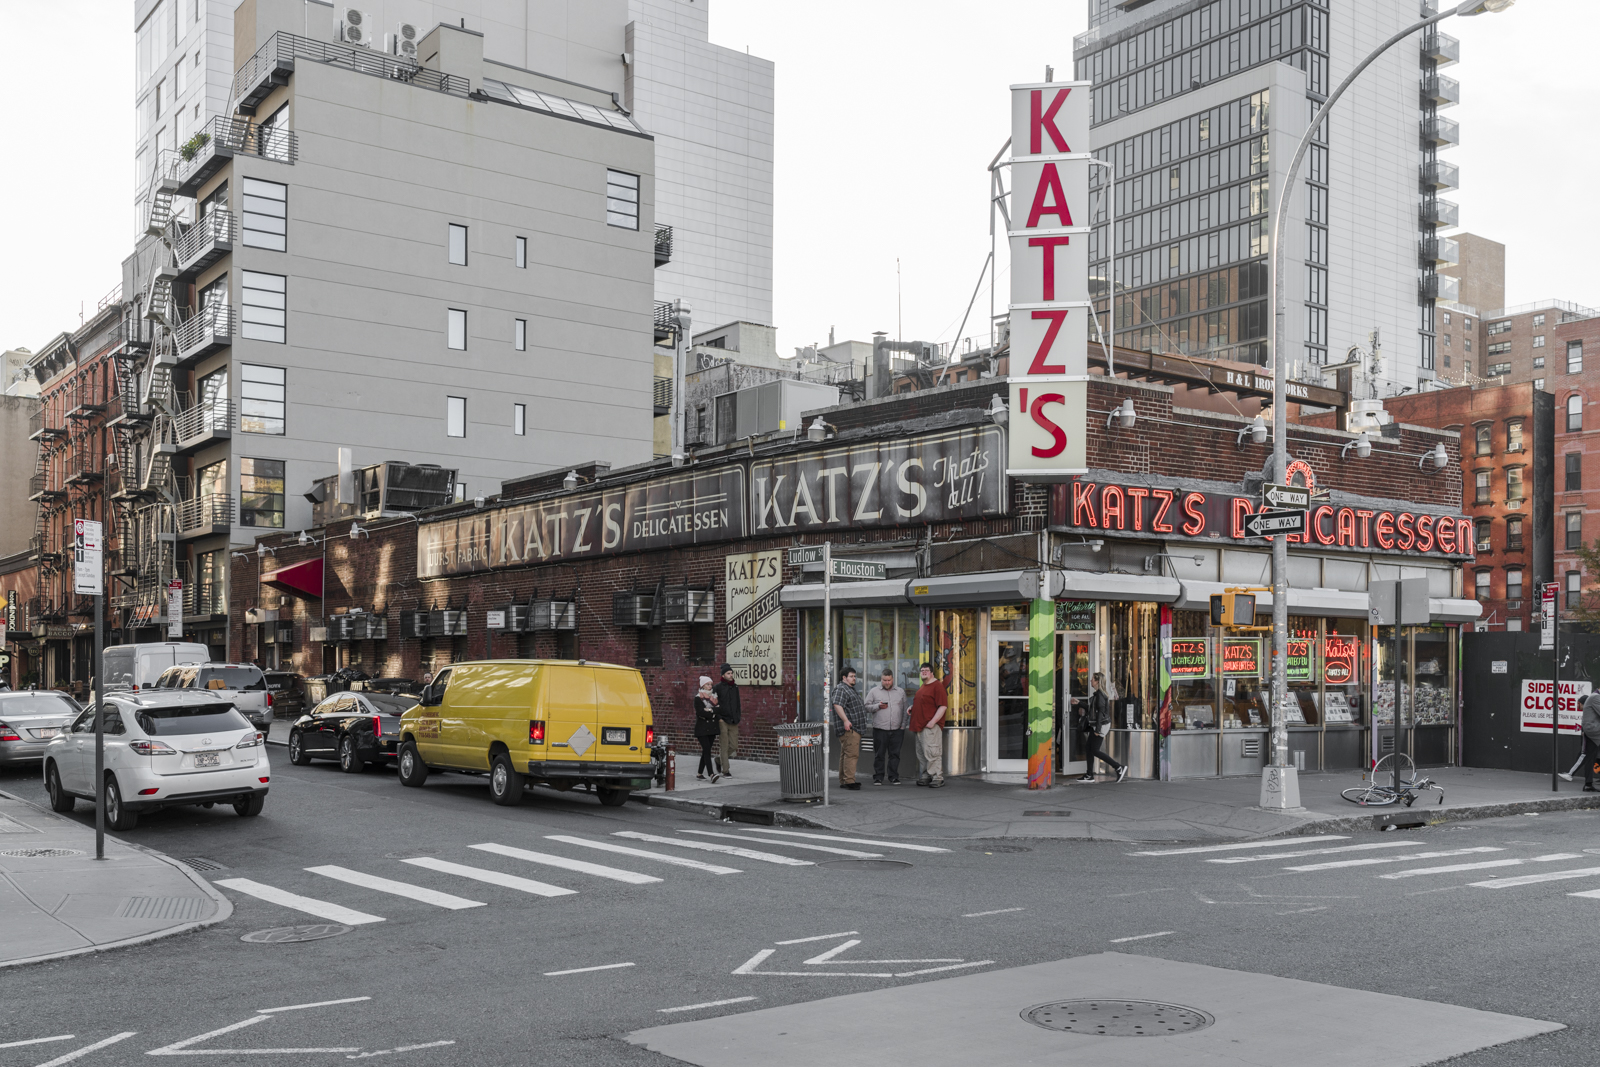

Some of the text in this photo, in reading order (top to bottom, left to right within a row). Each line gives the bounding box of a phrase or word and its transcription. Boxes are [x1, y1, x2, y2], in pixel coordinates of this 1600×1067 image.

[1018, 88, 1073, 459] KATZ'S
[1226, 371, 1234, 383] H
[1235, 373, 1243, 386] &
[1244, 375, 1250, 387] L
[1285, 383, 1309, 398] ORKS.
[756, 457, 928, 529] KATZ'S
[1270, 492, 1305, 503] ONE WAY
[633, 507, 729, 539] DELICATESSEN
[1232, 497, 1473, 556] DICATESSEN
[1253, 517, 1297, 530] ONE WAY
[498, 502, 622, 563] KATZ'S
[427, 545, 487, 567] WURST FABRIC
[789, 550, 816, 564] Ludlow
[728, 556, 778, 581] KATZ'S
[833, 562, 885, 577] E Houston St
[727, 590, 779, 641] DELICATESSEN
[747, 634, 775, 643] KNOWN
[733, 645, 770, 658] as the Best
[1224, 644, 1253, 659] KATZ'S
[1287, 642, 1307, 656] TZ'S
[1325, 639, 1356, 657] Katz's
[1171, 656, 1205, 665] LICATESSEN
[733, 669, 748, 679] INCE
[1228, 682, 1235, 692] A
